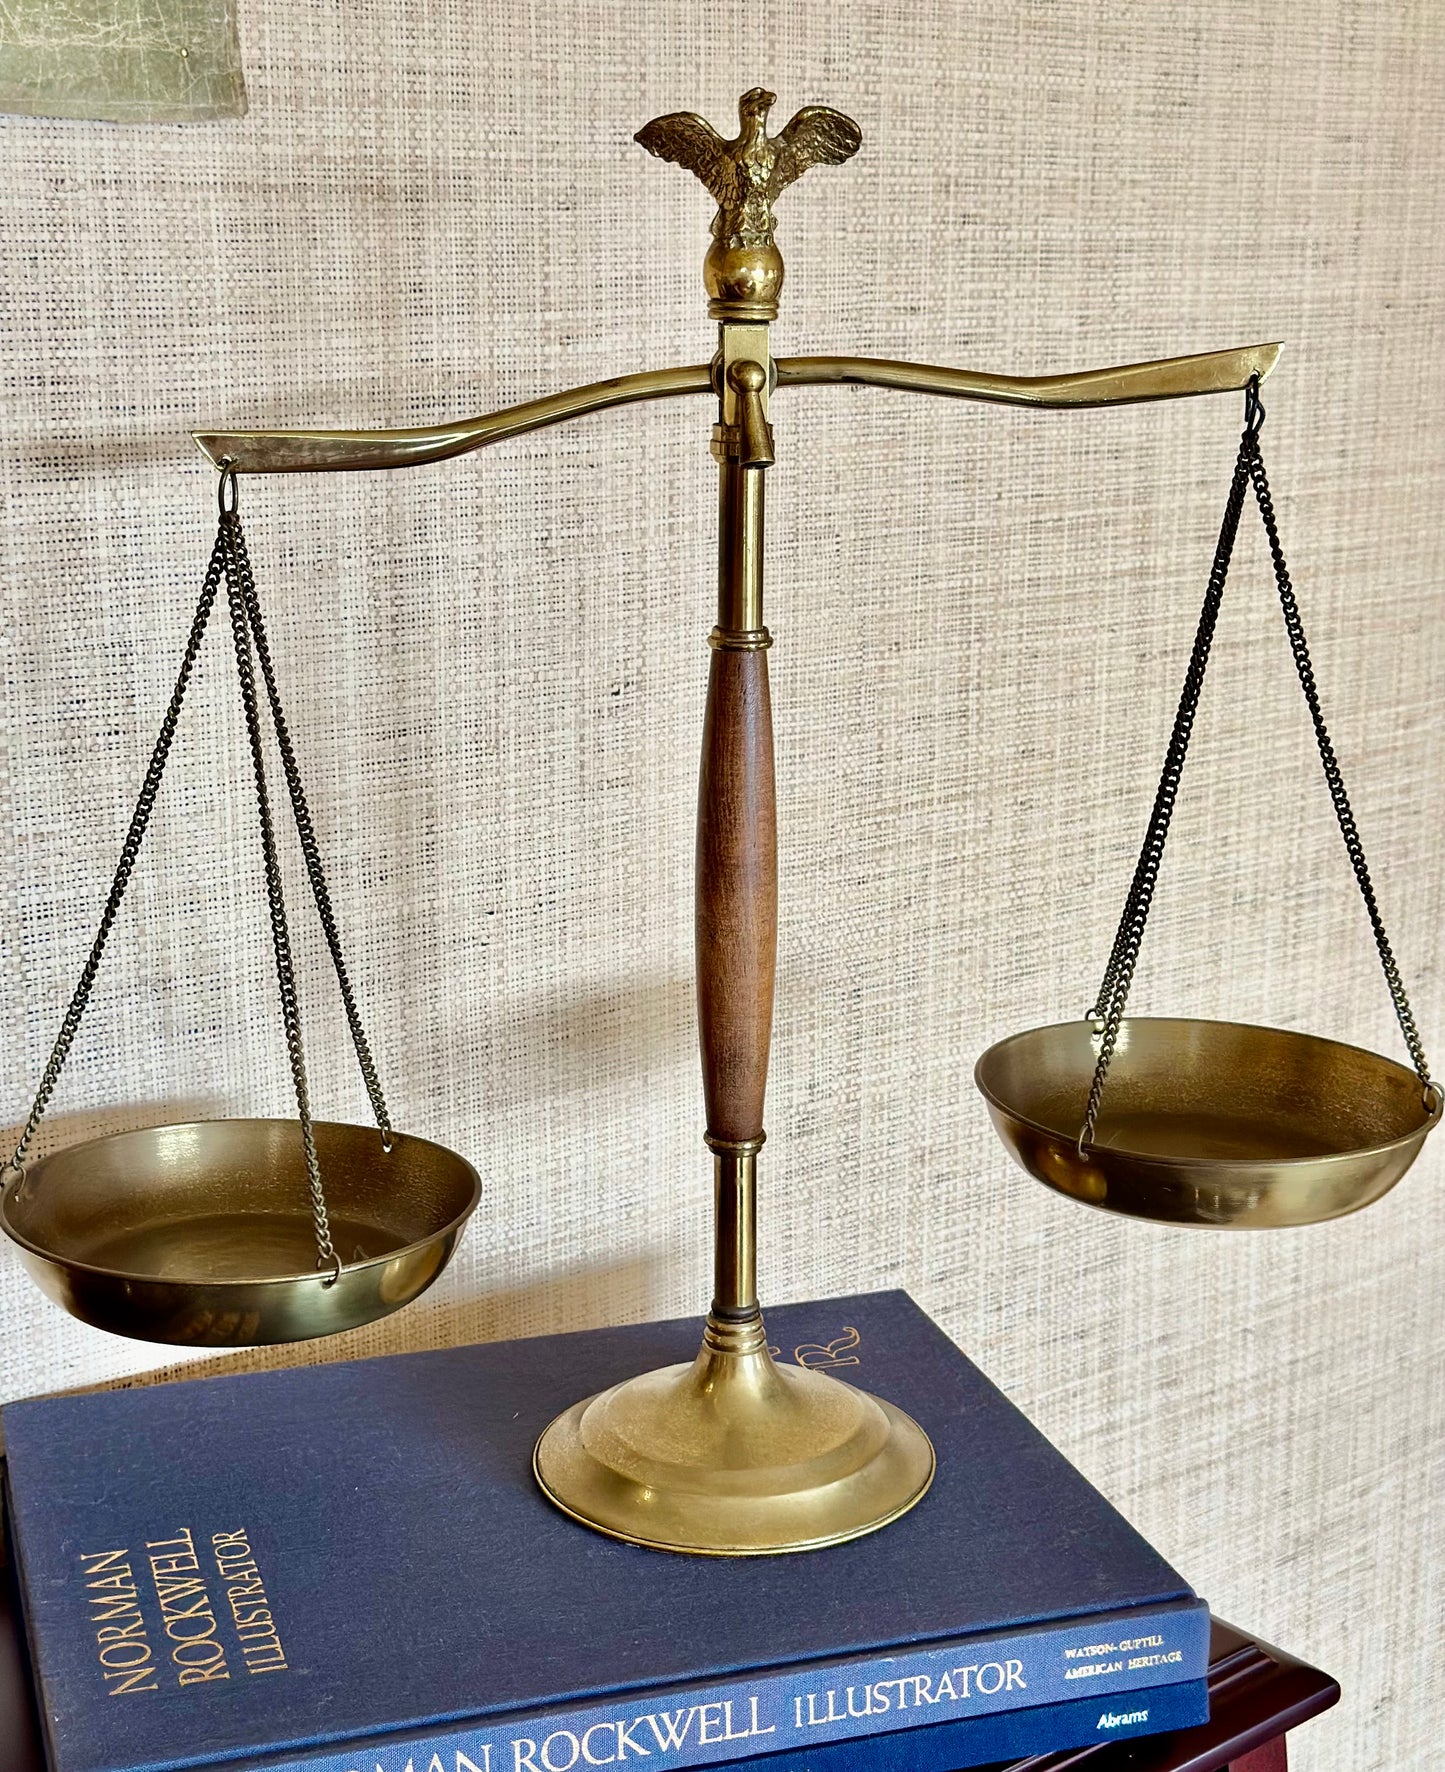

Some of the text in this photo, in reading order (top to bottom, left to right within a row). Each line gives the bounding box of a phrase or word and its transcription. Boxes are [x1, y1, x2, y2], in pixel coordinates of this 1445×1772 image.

[80, 1548, 159, 1696] NORMAN
[145, 1526, 231, 1687] ROCKWELL
[211, 1527, 289, 1674] ILLUSTRATOR
[1064, 1649, 1183, 1680] AMERICAN HERITAGE
[510, 1659, 1027, 1772] ROCKWELL ILLUSTRATOR
[1096, 1708, 1149, 1729] Abrams
